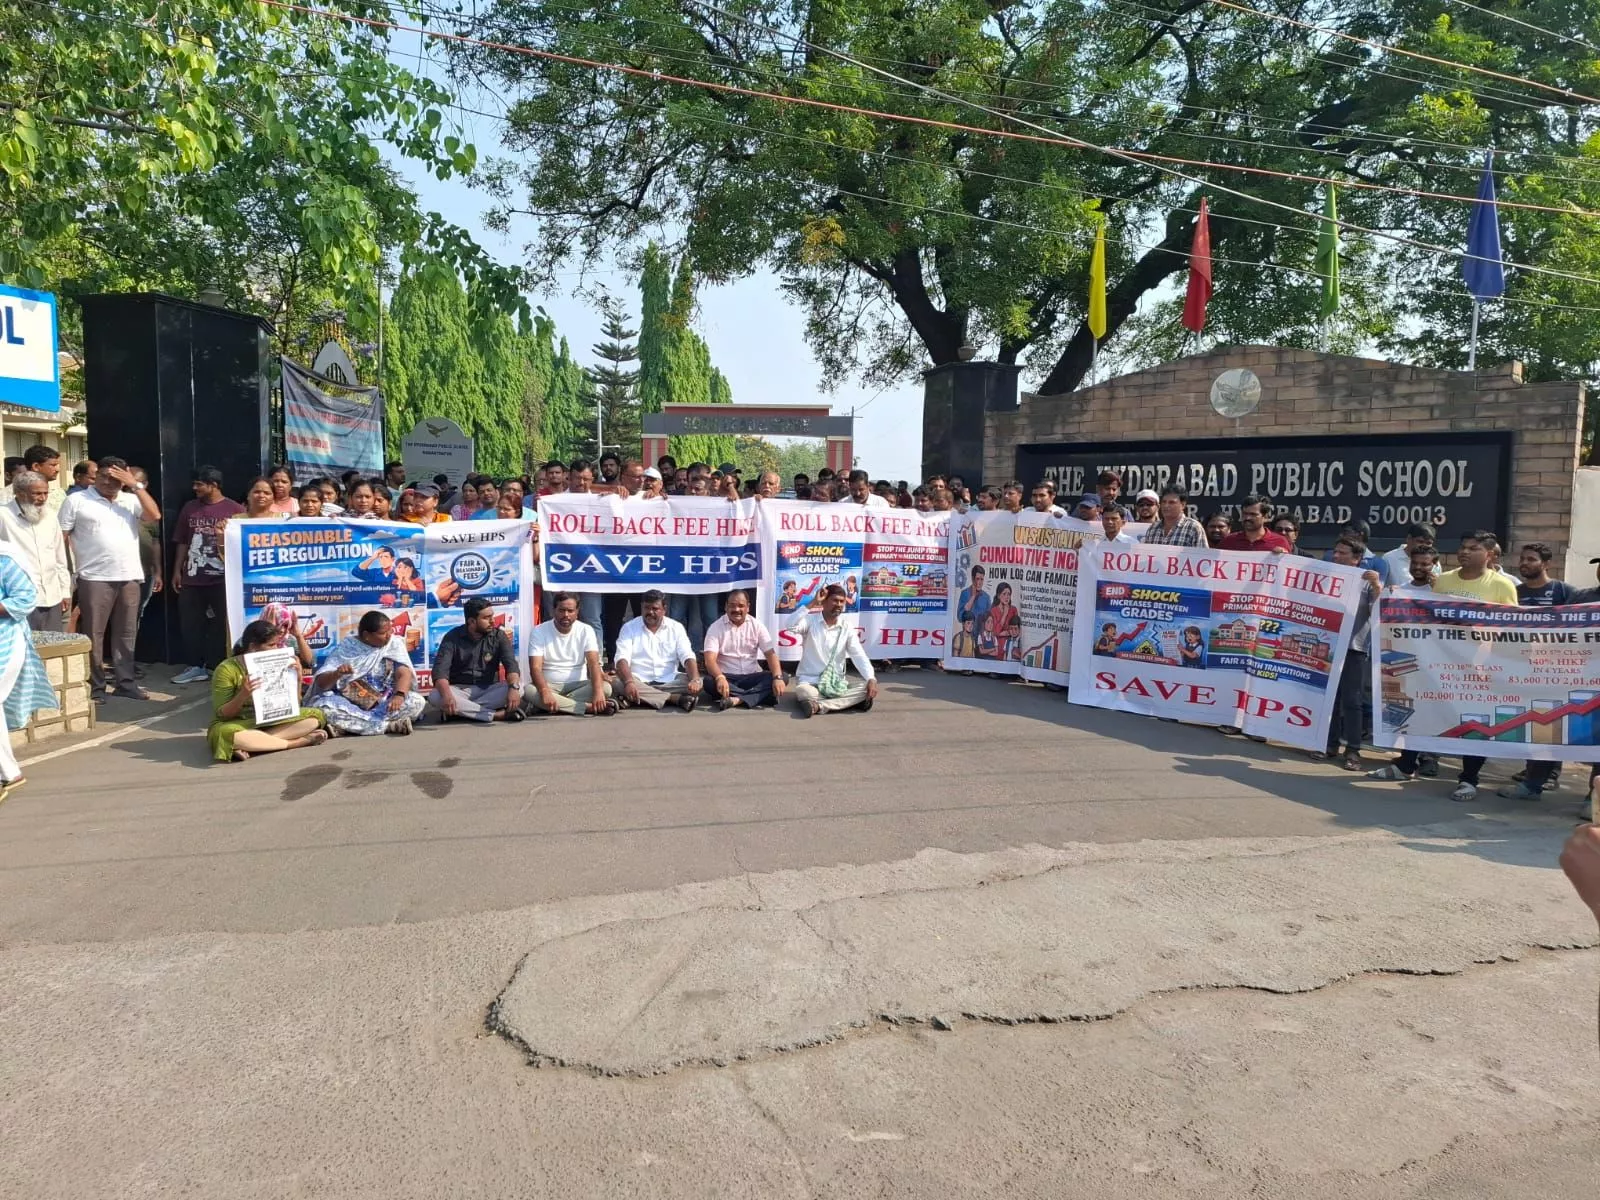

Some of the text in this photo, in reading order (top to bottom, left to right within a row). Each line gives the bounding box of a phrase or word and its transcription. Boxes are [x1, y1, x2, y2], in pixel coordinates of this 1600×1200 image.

[1044, 466, 1085, 497] THE
[1250, 461, 1344, 497] PUBLIC
[1357, 459, 1473, 498] SCHOOL
[1368, 505, 1447, 526] 500013
[549, 513, 606, 534] ROLL
[612, 516, 667, 536] BACK
[673, 517, 710, 537] FEE
[779, 512, 827, 532] ROLL
[831, 515, 876, 533] BACK
[880, 517, 912, 536] FEE
[248, 528, 353, 548] REASONABLE
[440, 531, 506, 544] SAVE HPS
[248, 542, 374, 567] FEE REGULATION
[784, 544, 845, 557] END SHOCK
[871, 552, 898, 560] PRIMARY
[876, 545, 894, 553] STOP
[895, 546, 907, 554] THE
[907, 546, 925, 554] JUMP
[459, 559, 475, 567] FAIR
[549, 551, 758, 575] SAVE HPS
[789, 556, 823, 564] INCREASES
[798, 563, 840, 574] GRADES
[903, 565, 920, 576] ???
[988, 566, 1008, 580] HOW
[1025, 572, 1045, 584] CAN
[1102, 551, 1345, 598] ROLL BACK FEE HIKE
[252, 586, 262, 594] Fee
[263, 586, 289, 594] increases
[311, 586, 332, 594] capped
[344, 585, 363, 593] aligned
[1105, 586, 1181, 603] END SHOCK
[252, 593, 345, 603] NOT arbitrary hikes every year.
[1229, 594, 1255, 604] STOP
[1266, 598, 1291, 609] JUMP
[1292, 602, 1314, 615] FROM
[1110, 599, 1190, 613] INCREASES BETWEEN
[1121, 606, 1175, 622] GRADES
[1222, 602, 1258, 612] PRIMARY
[1291, 611, 1327, 626] SCHOOL!
[1433, 608, 1456, 618] FEE
[1459, 609, 1556, 622] PROJECTIONS:
[1559, 612, 1587, 622] THE
[1259, 619, 1280, 633] ???
[879, 627, 946, 647] HPS
[1436, 628, 1467, 641] THE
[1470, 630, 1579, 644] CUMULATIVE
[1220, 656, 1239, 665] FAIR
[1264, 663, 1311, 681] TRANSITIONS
[1475, 664, 1504, 672] CLASS
[1557, 658, 1587, 667] HIKE
[1256, 670, 1278, 681] KIDS!
[1463, 673, 1493, 683] HIKE
[1552, 667, 1582, 675] YEARS
[1460, 683, 1490, 691] YEARS
[1544, 677, 1560, 685] TO
[1095, 671, 1217, 706] SAVE
[1459, 692, 1474, 701] TO
[1476, 693, 1521, 704] 2,08,000
